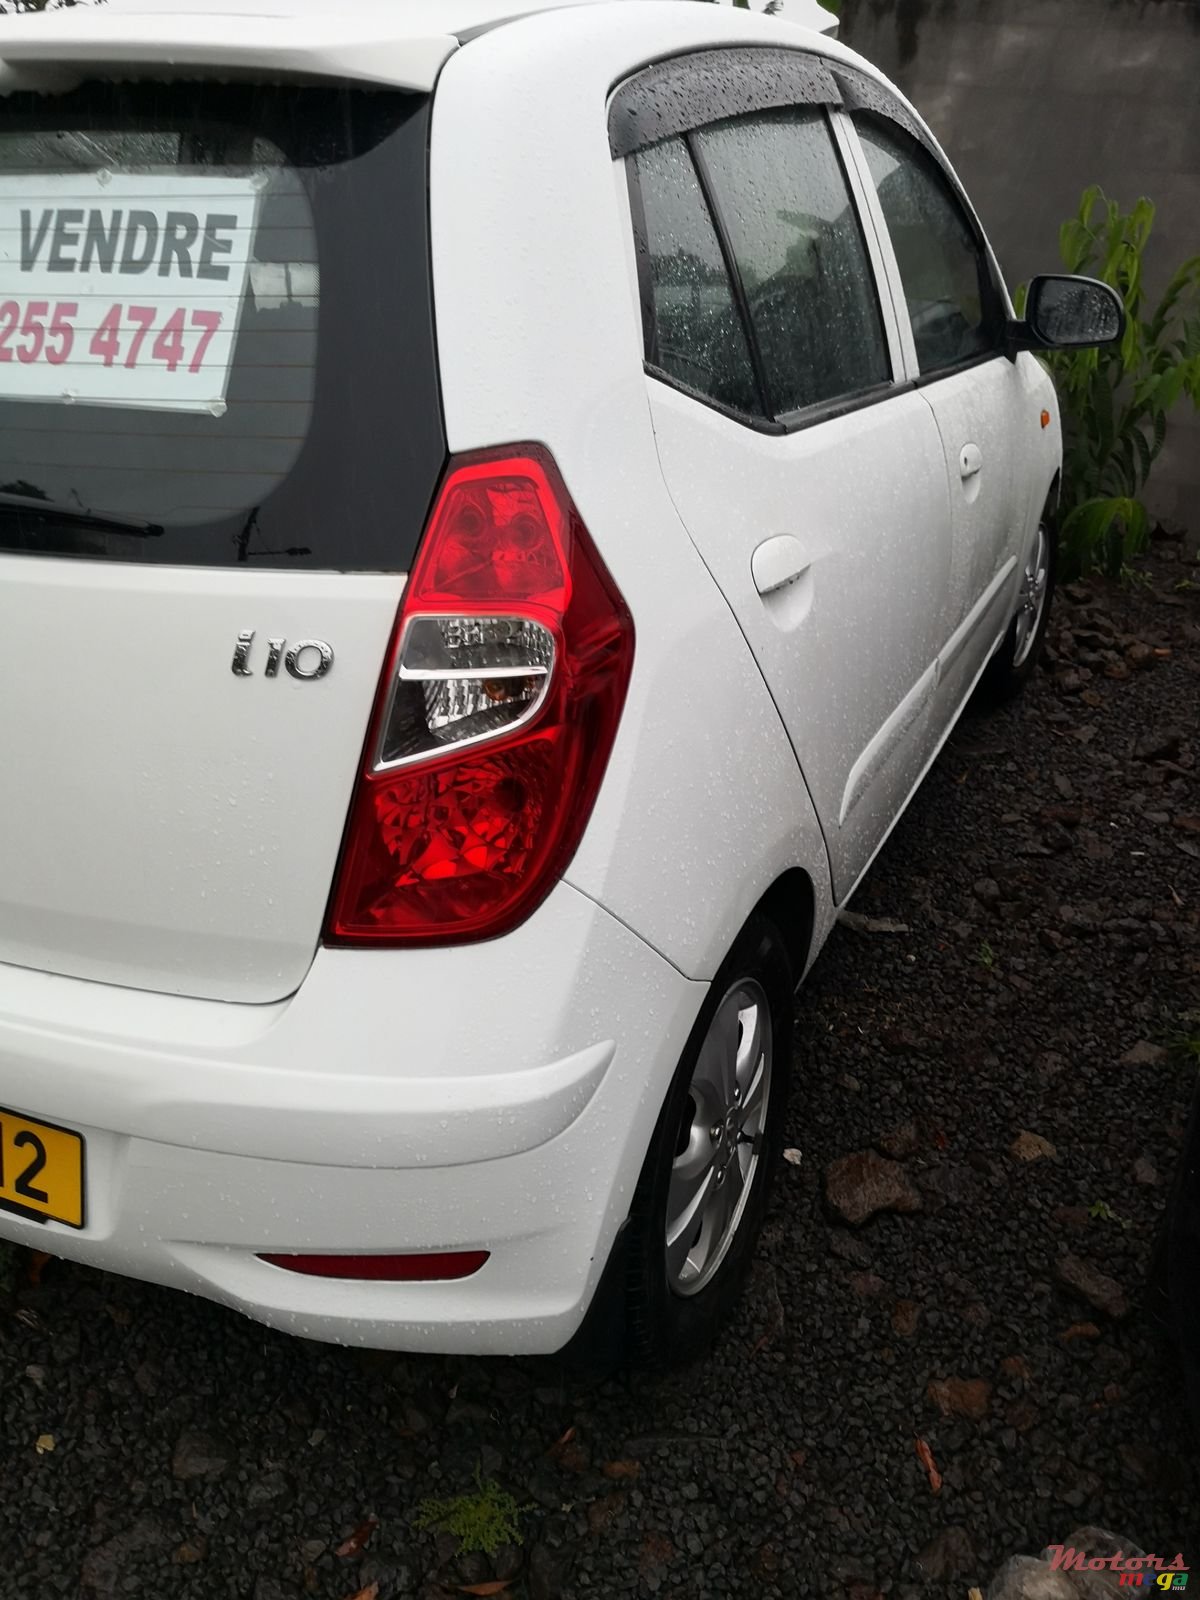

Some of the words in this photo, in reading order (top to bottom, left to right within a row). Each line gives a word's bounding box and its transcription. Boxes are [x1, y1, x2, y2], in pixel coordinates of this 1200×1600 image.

[20, 208, 238, 281] VENDRE
[0, 300, 79, 366] 255
[89, 303, 223, 374] 4747
